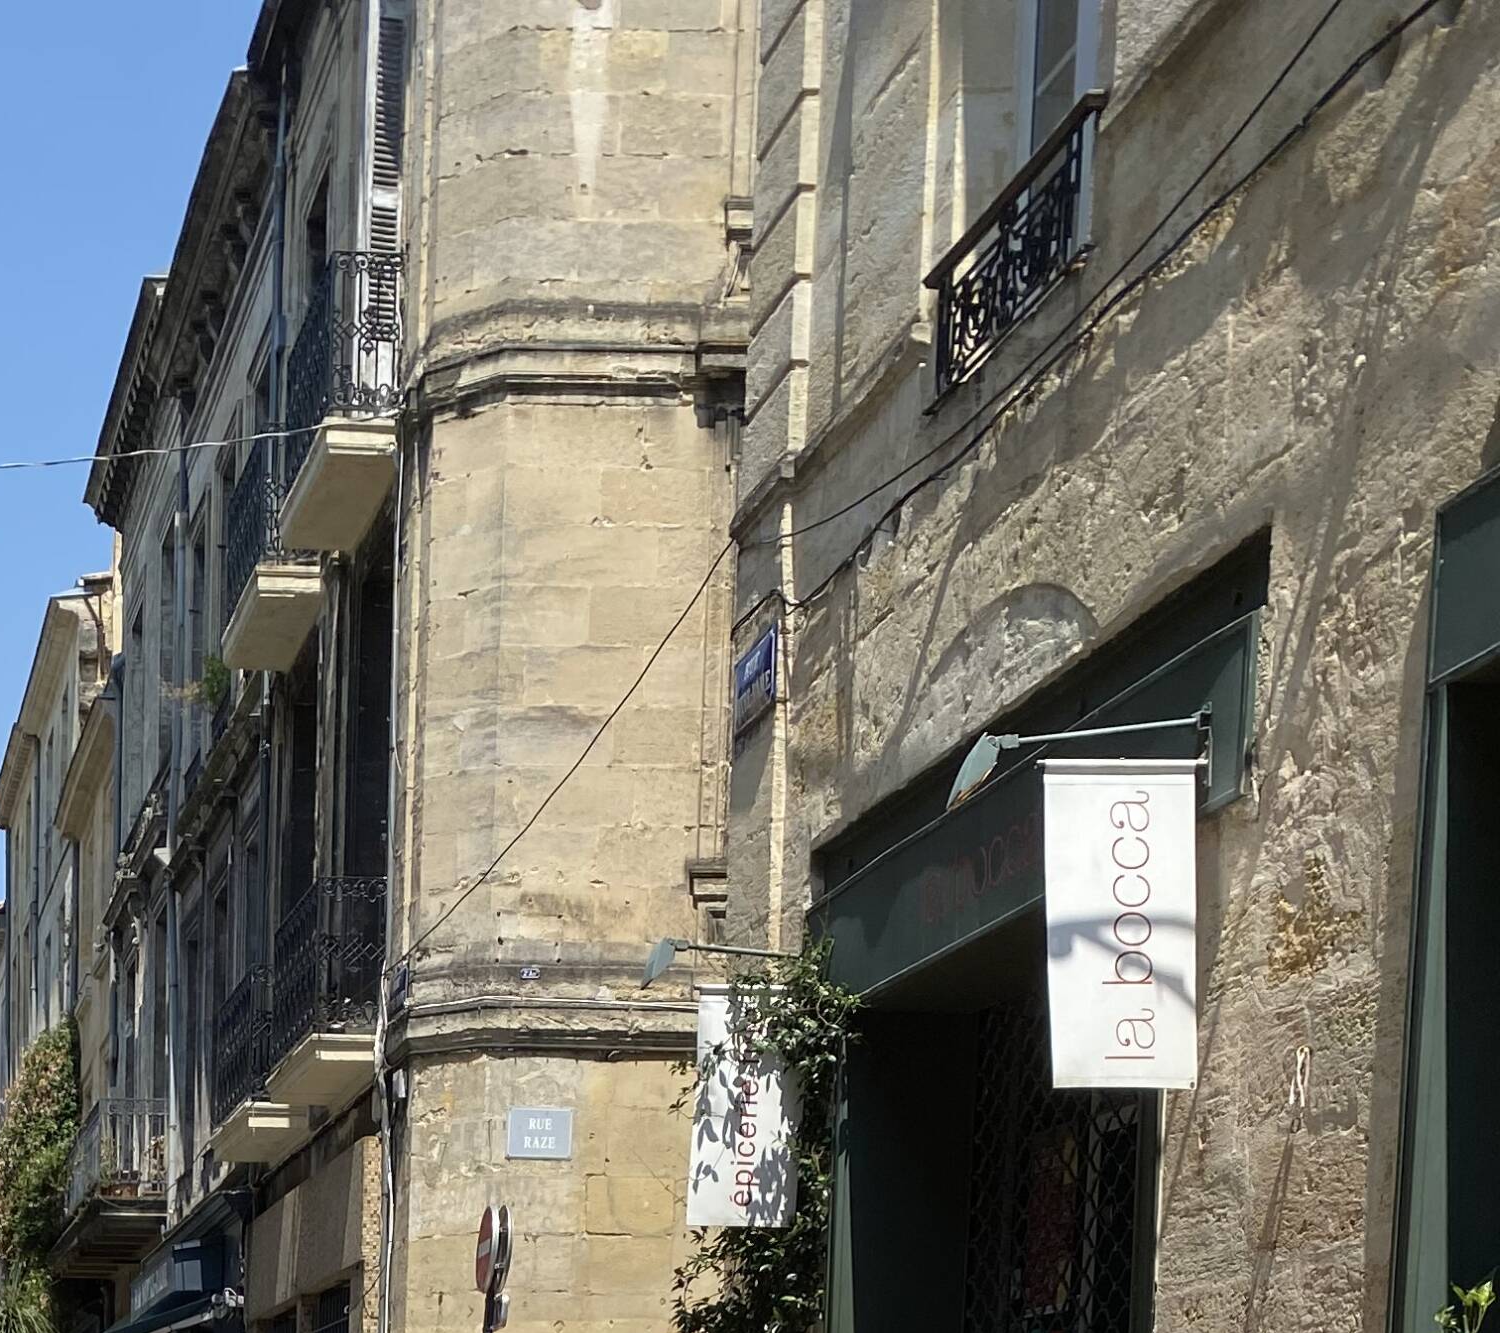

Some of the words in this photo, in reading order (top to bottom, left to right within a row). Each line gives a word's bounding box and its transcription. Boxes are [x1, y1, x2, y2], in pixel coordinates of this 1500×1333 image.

[1102, 790, 1153, 985] bocca
[1104, 1008, 1155, 1060] la
[524, 1136, 556, 1149] RAZE
[528, 1117, 553, 1130] RUE
[729, 1078, 760, 1208] épicerie
